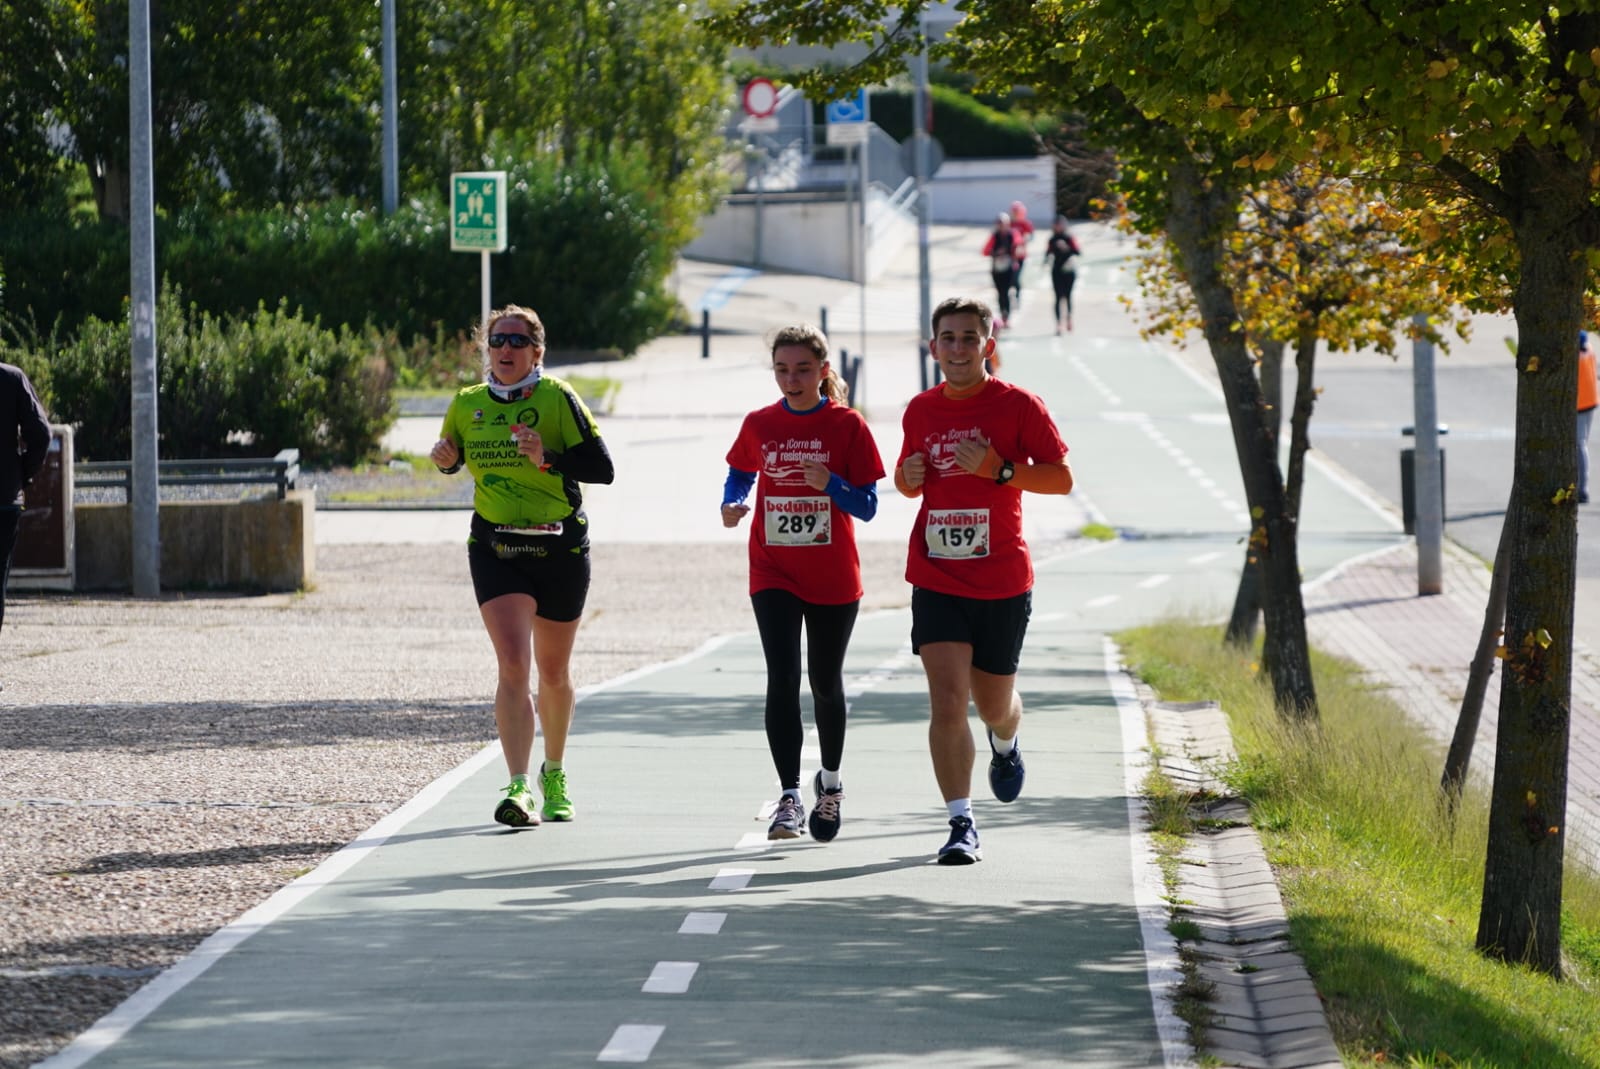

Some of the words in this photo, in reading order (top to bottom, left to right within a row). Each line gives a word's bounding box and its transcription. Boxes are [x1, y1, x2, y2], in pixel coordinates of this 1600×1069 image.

[810, 438, 822, 450] sin
[477, 461, 523, 469] SALAMANCA
[778, 514, 816, 534] 289
[938, 527, 975, 547] 159
